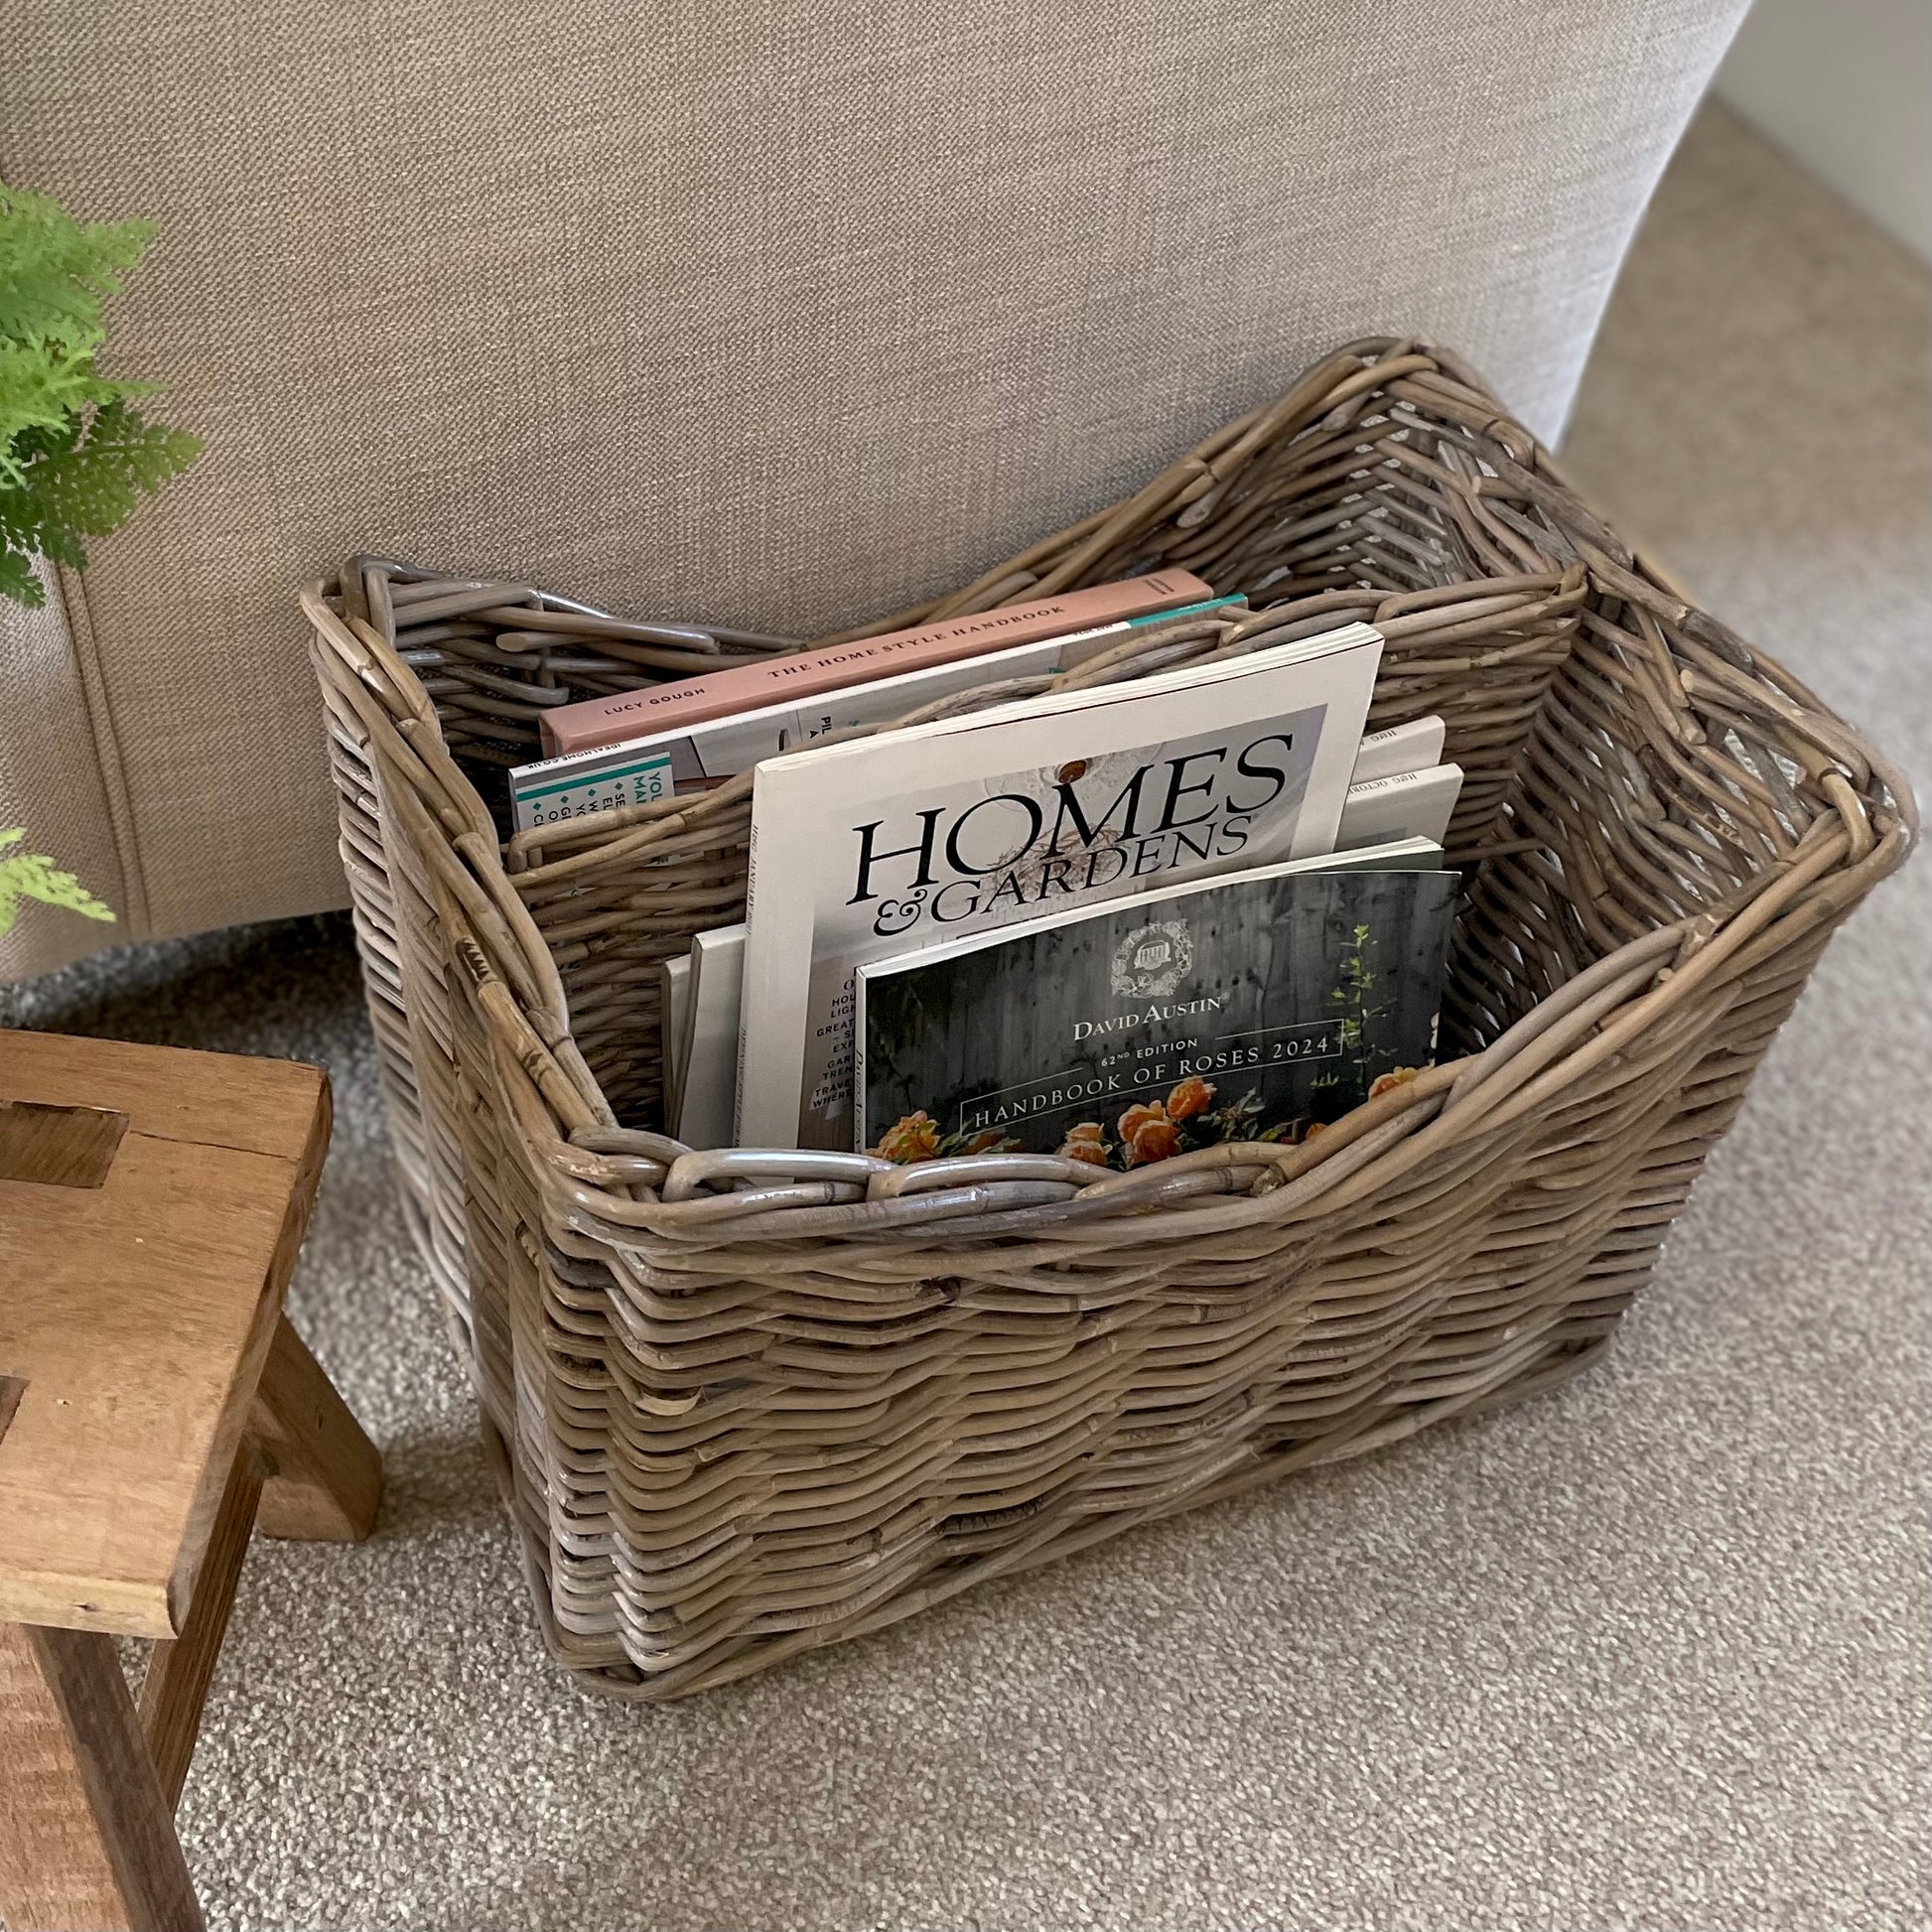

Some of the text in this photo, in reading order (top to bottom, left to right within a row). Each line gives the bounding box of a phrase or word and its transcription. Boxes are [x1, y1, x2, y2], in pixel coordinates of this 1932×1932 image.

[767, 663, 811, 678] THE
[817, 648, 879, 668] HOME
[883, 632, 946, 652] STYLE
[952, 606, 1066, 636] HANDBOOK
[604, 688, 706, 715] LUCY GOUGH
[846, 733, 1294, 907] HOMES
[1073, 996, 1222, 1041] DAVID AUSTIN
[1101, 1037, 1198, 1067] 62ND EDITION
[975, 1036, 1328, 1128] HANDBOOK OF ROSES 2024
